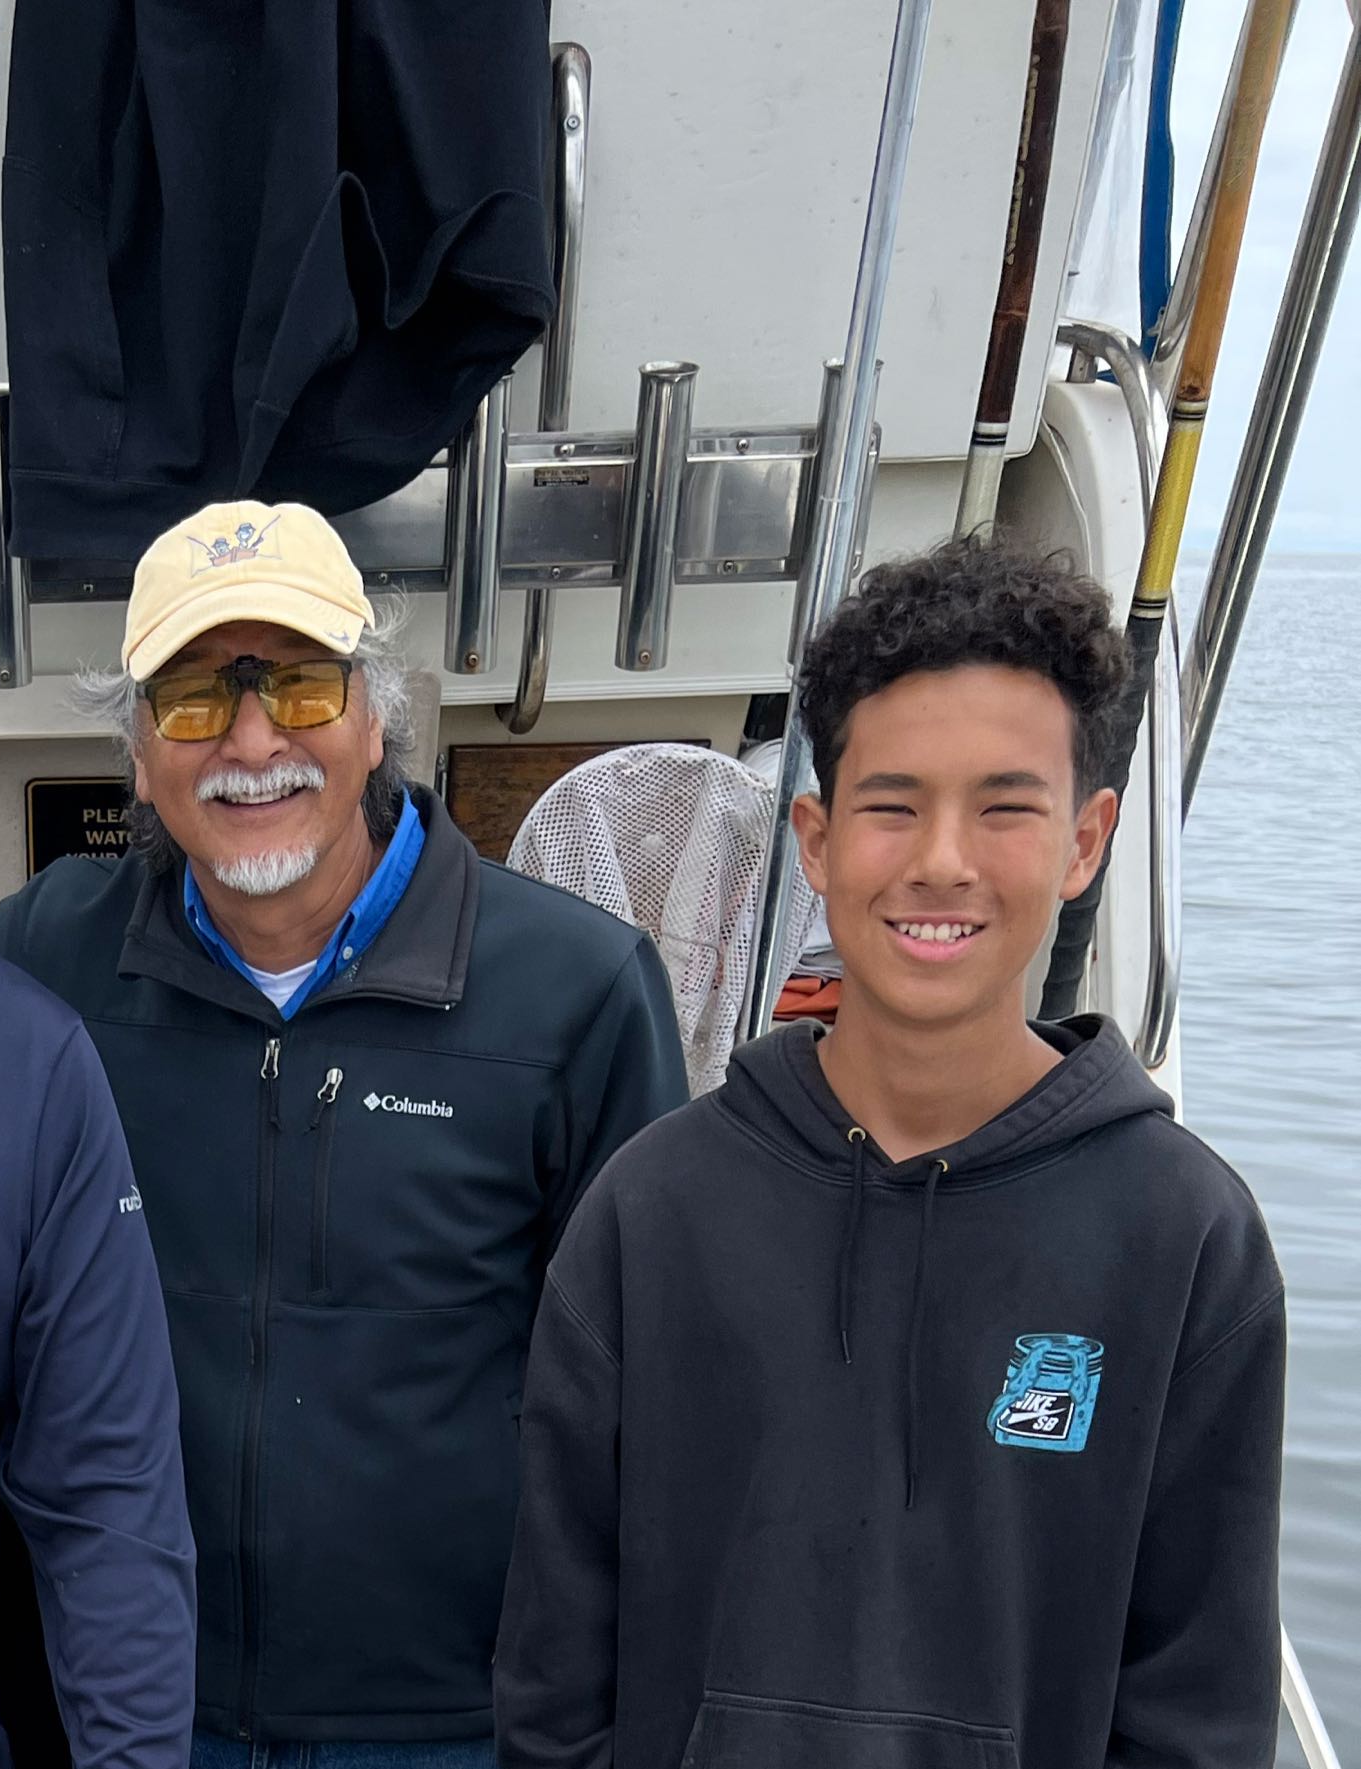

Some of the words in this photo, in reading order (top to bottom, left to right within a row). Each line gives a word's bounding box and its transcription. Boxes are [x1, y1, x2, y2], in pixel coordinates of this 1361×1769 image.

[82, 808, 130, 823] PLEA
[381, 1094, 454, 1118] Columbia
[1032, 1415, 1059, 1432] SB
